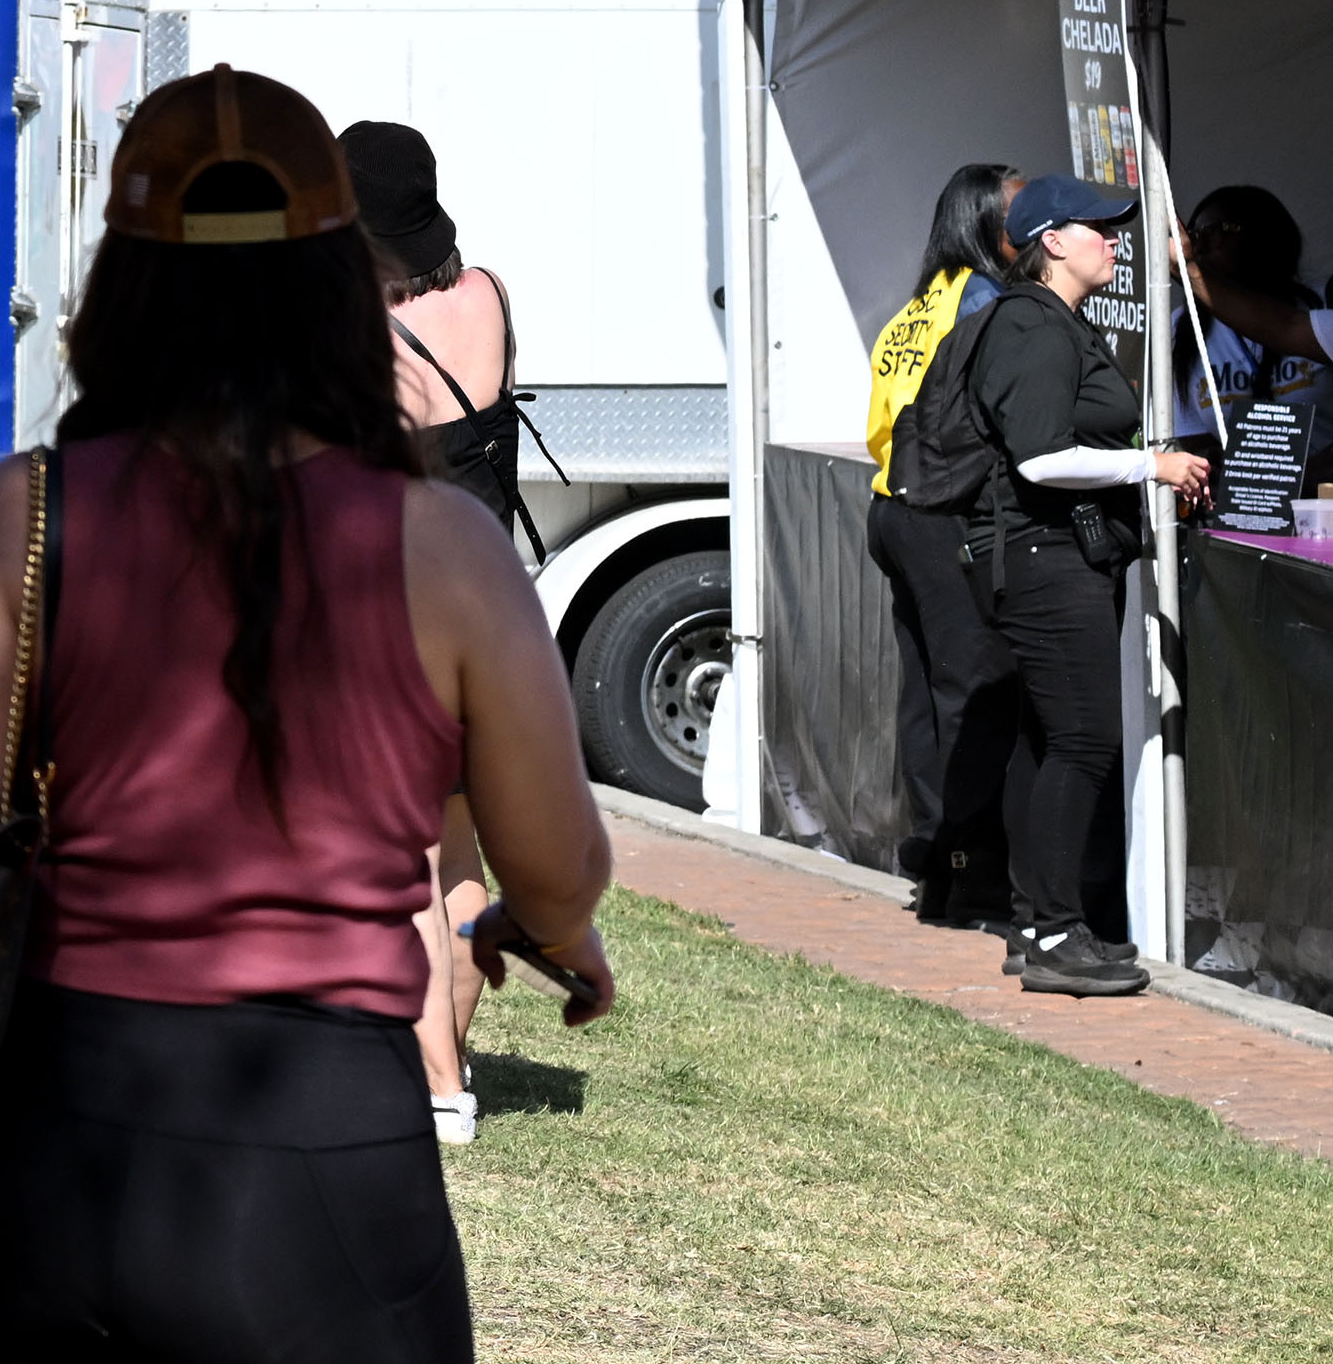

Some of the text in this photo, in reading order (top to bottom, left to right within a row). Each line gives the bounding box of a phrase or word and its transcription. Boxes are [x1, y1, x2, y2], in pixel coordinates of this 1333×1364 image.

[1062, 18, 1122, 55] CHELADA
[1084, 60, 1102, 91] $19
[1102, 264, 1134, 296] TER
[885, 319, 934, 347] SECITY
[878, 348, 925, 377] STFF
[1211, 361, 1296, 393] Molo
